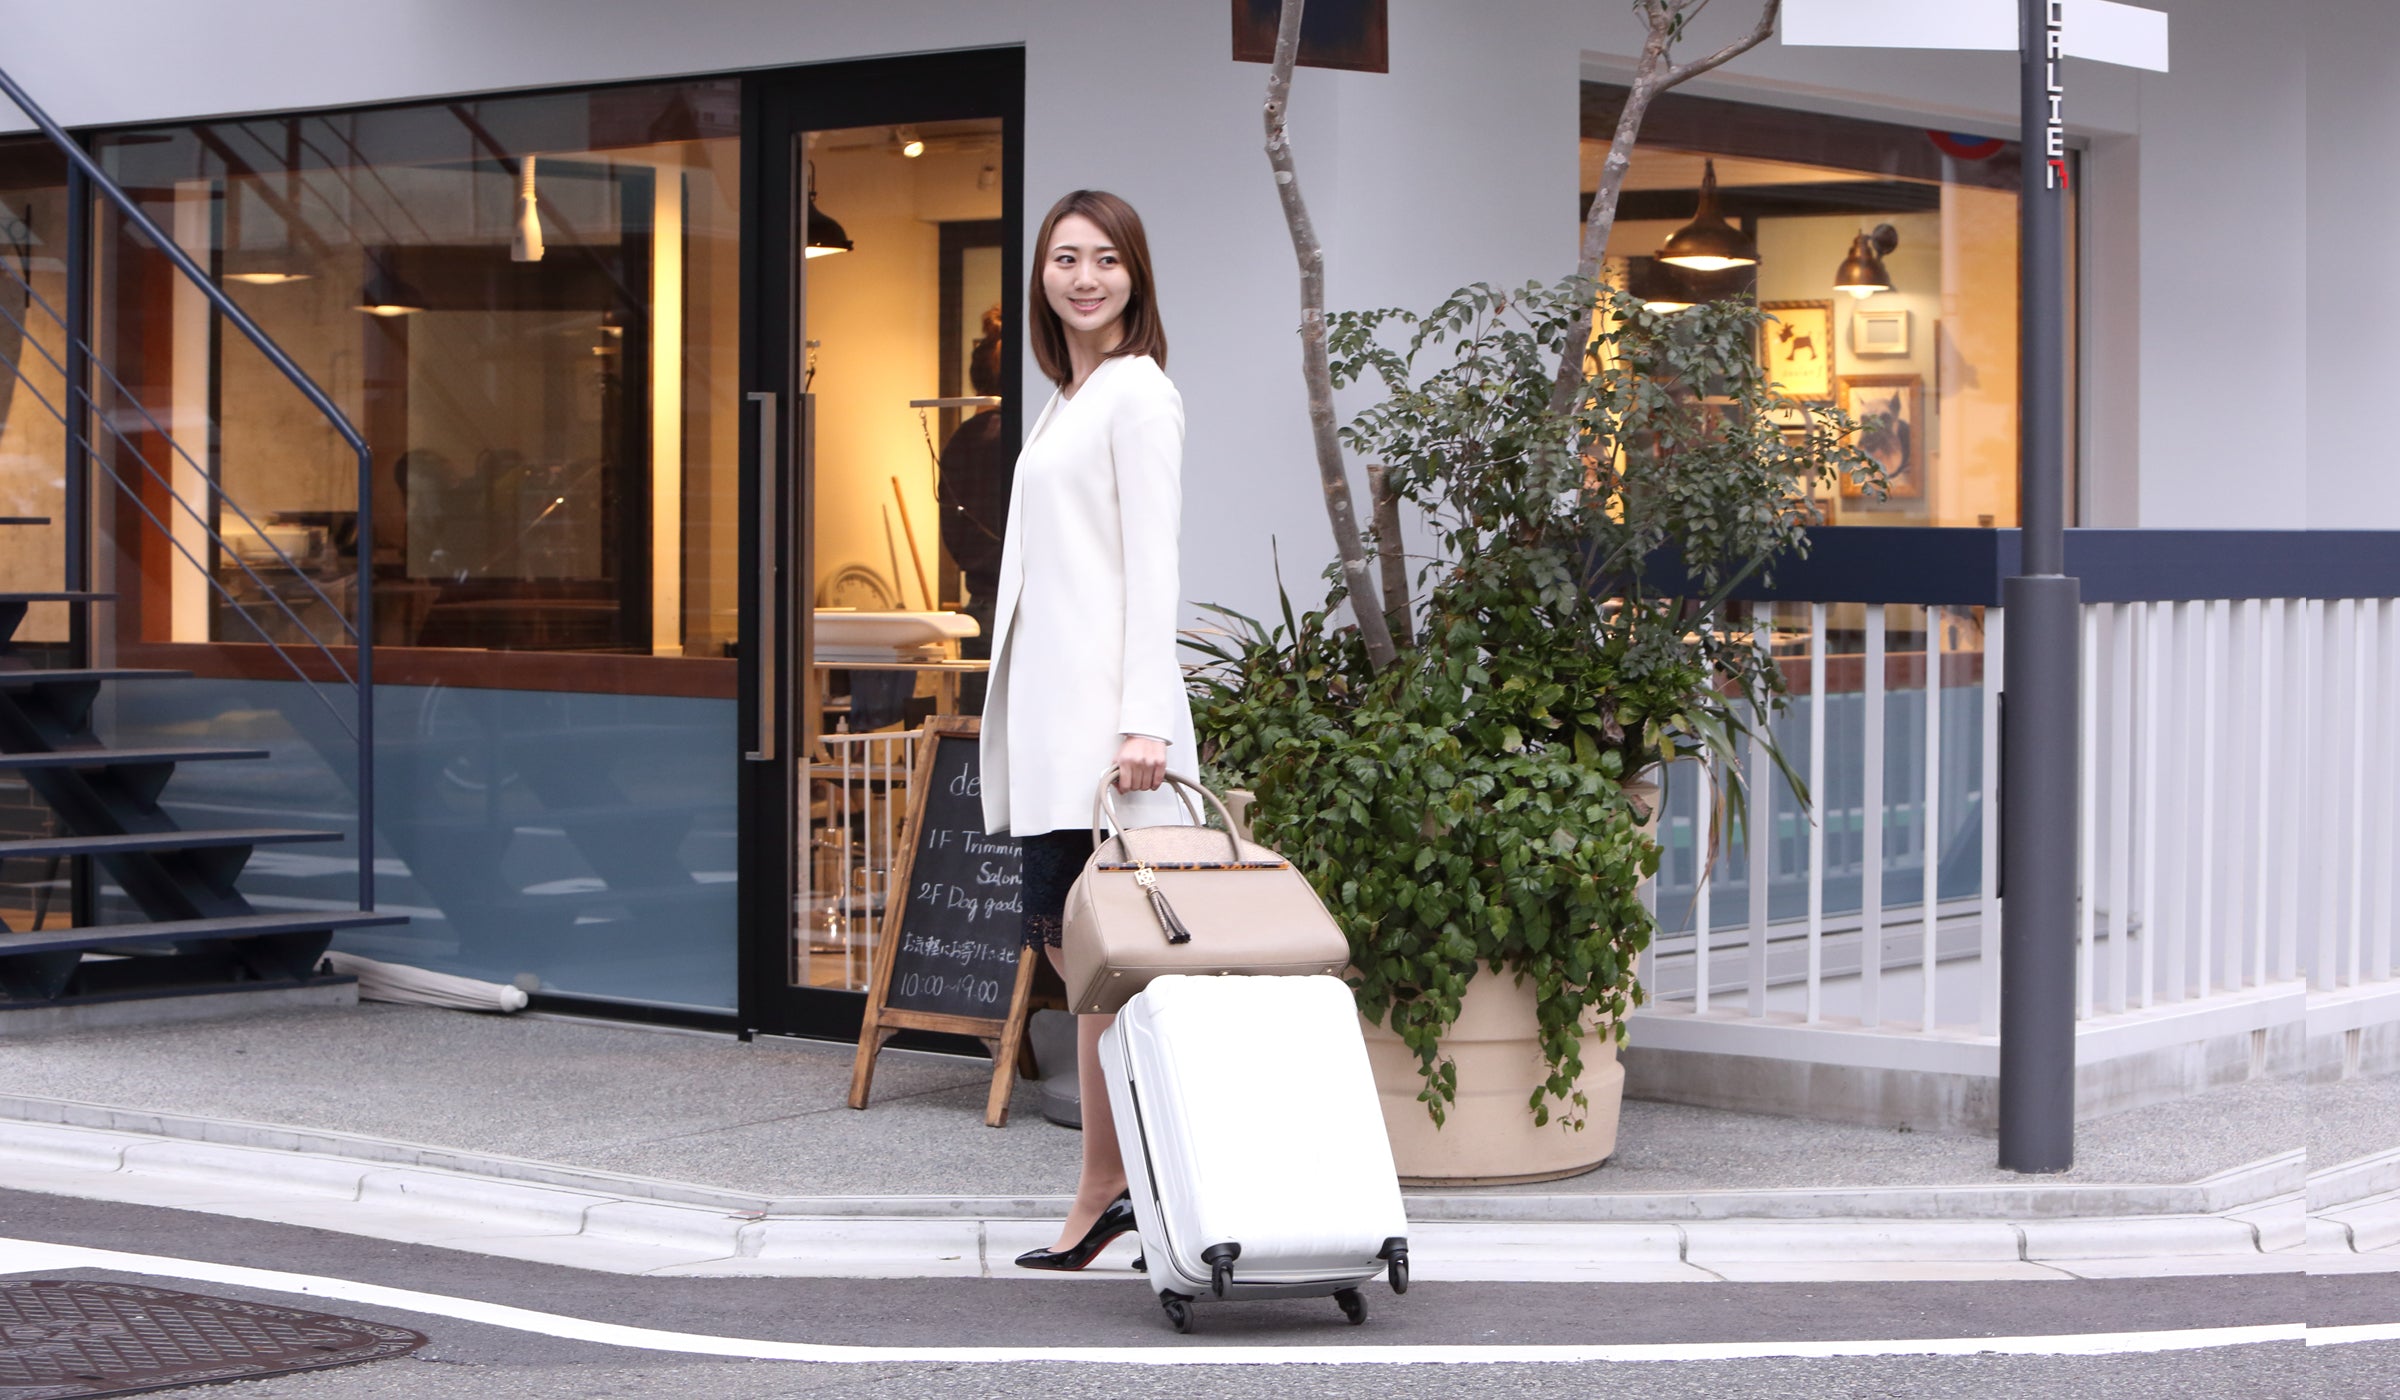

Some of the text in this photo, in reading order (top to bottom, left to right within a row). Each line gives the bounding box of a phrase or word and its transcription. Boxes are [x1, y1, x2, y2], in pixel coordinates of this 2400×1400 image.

[949, 762, 981, 797] de
[962, 830, 1023, 857] Trimmin
[917, 882, 1023, 923] 2F Dog goods
